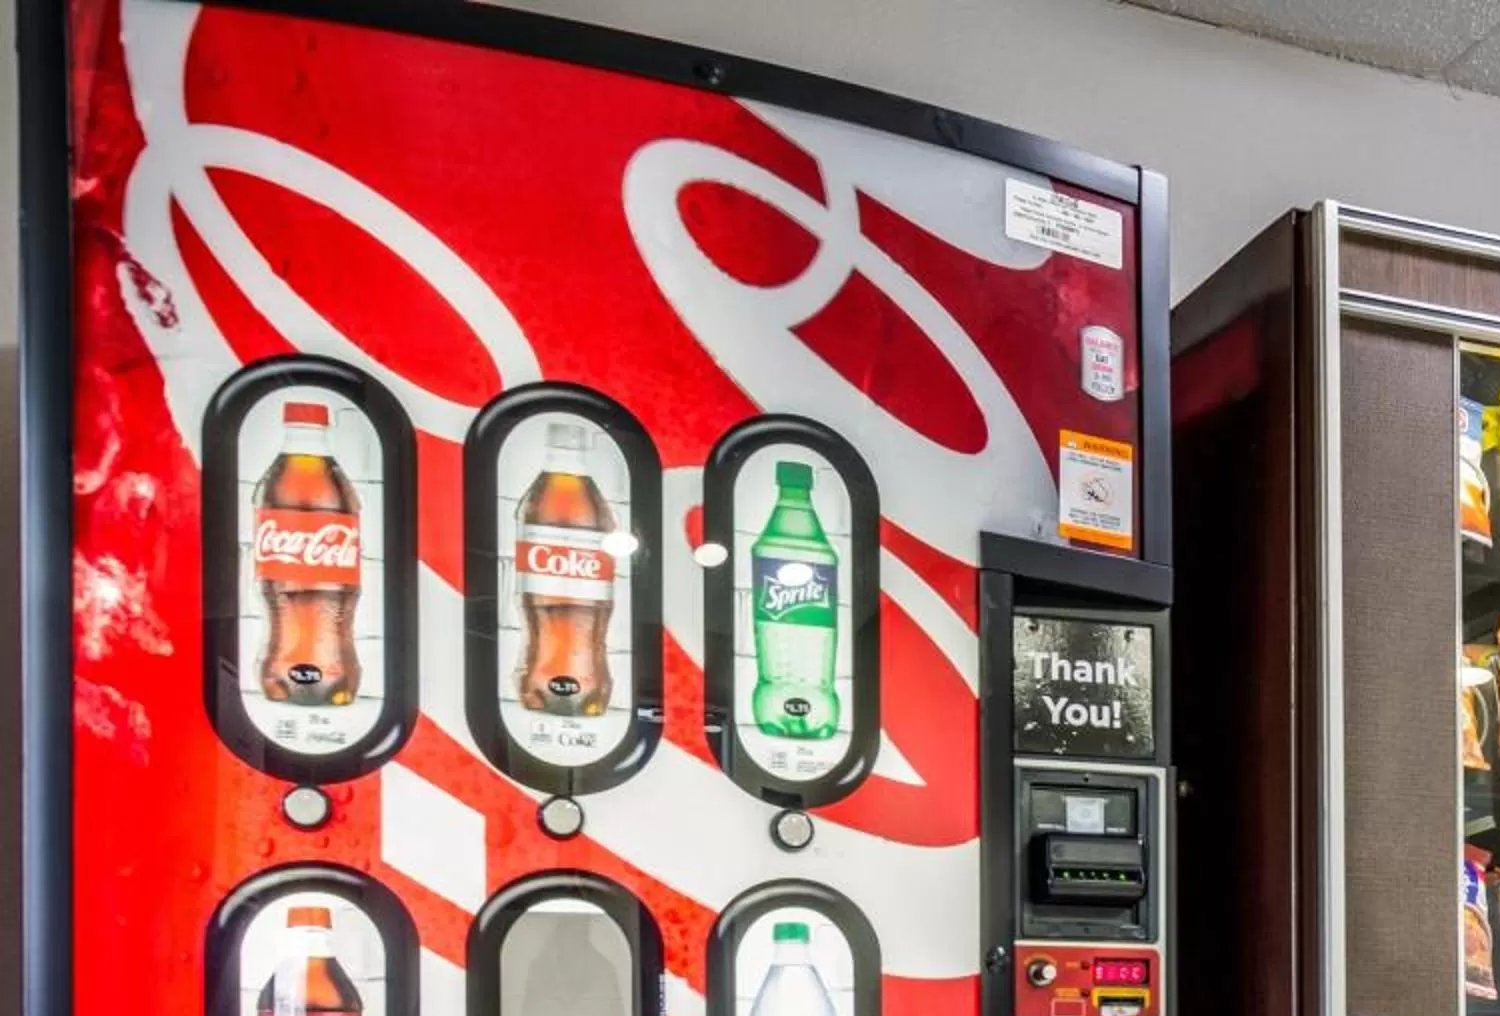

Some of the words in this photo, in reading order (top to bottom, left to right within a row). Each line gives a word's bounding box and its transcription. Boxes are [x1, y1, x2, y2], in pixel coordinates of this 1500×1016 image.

[256, 519, 358, 568] Coca-Cola
[527, 545, 601, 578] Coke
[765, 581, 824, 610] Sprite
[1028, 651, 1138, 686] Thank
[1041, 695, 1122, 729] You!
